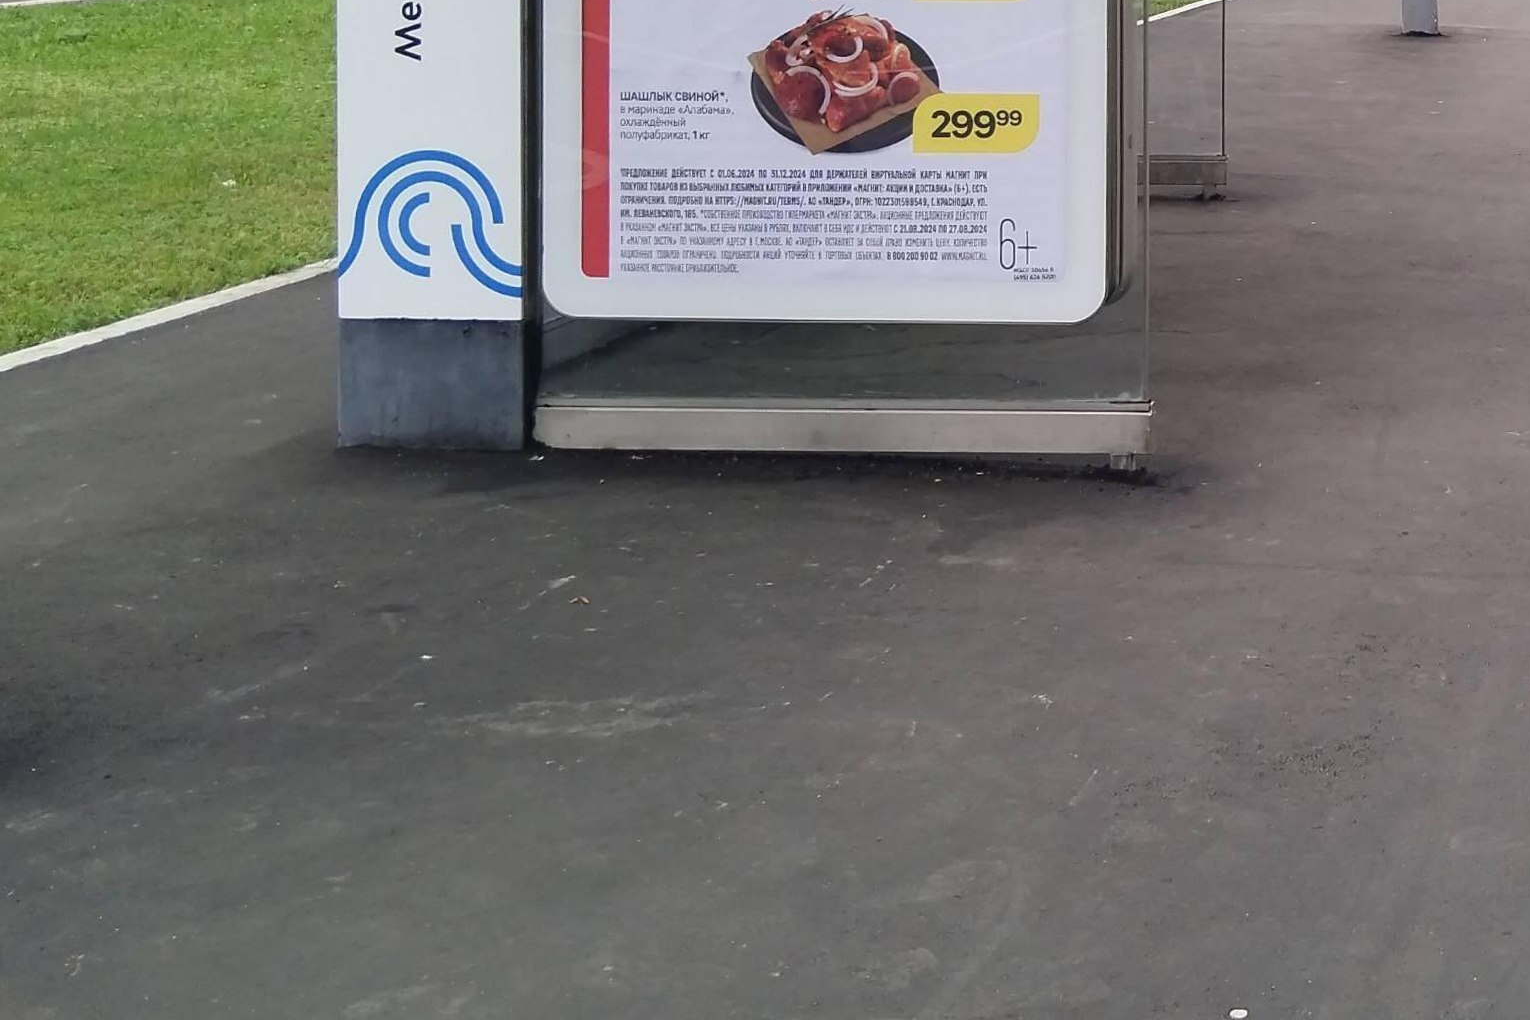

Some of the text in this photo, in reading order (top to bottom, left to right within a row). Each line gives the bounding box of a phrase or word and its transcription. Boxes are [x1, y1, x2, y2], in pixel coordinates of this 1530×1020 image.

[620, 91, 672, 101] ШАШЛЫК
[628, 106, 675, 116] маринаде
[620, 117, 686, 127] охлаждённый
[930, 110, 1023, 139] 299 99
[700, 132, 710, 140] кг
[999, 218, 1038, 270] 6+
